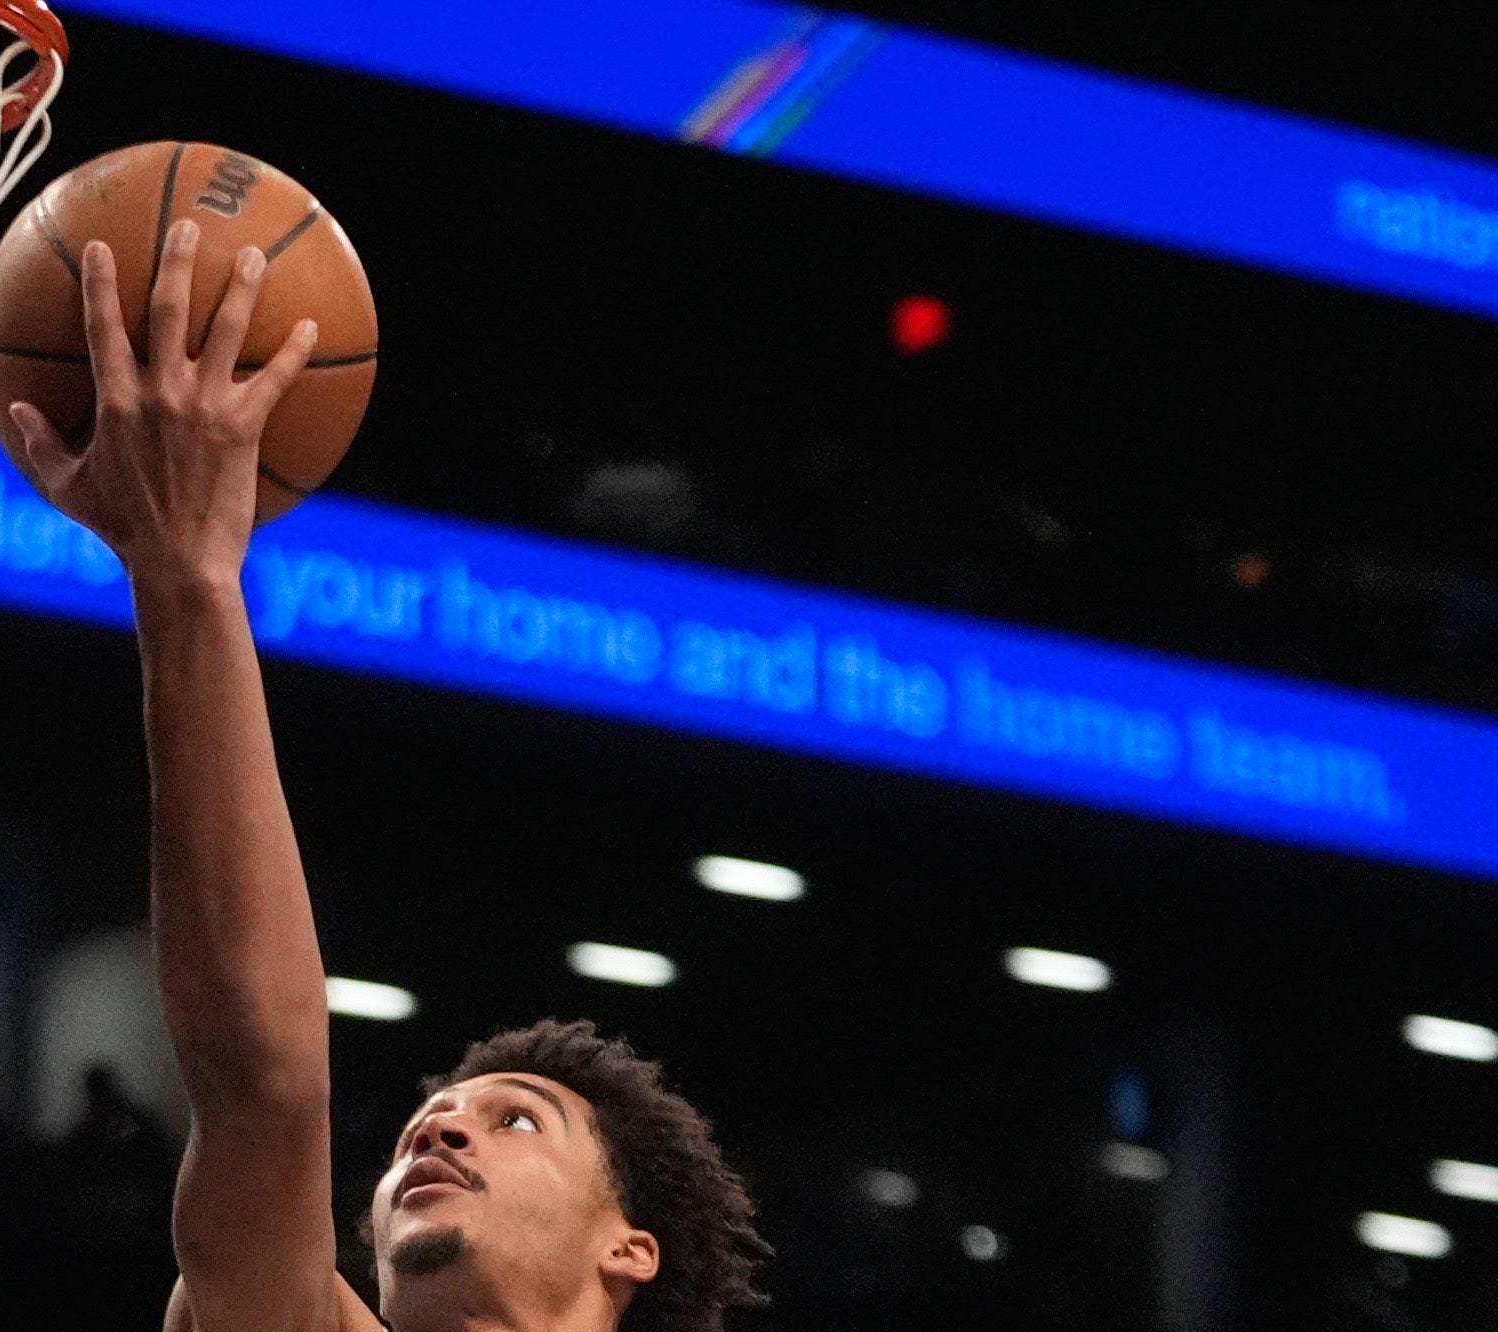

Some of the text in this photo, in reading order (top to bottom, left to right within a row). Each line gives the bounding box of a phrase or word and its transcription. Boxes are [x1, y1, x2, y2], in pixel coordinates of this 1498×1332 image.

[246, 542, 426, 641] your
[433, 555, 663, 685] home
[667, 620, 816, 715] and
[823, 633, 948, 739] the
[955, 654, 1181, 782] home
